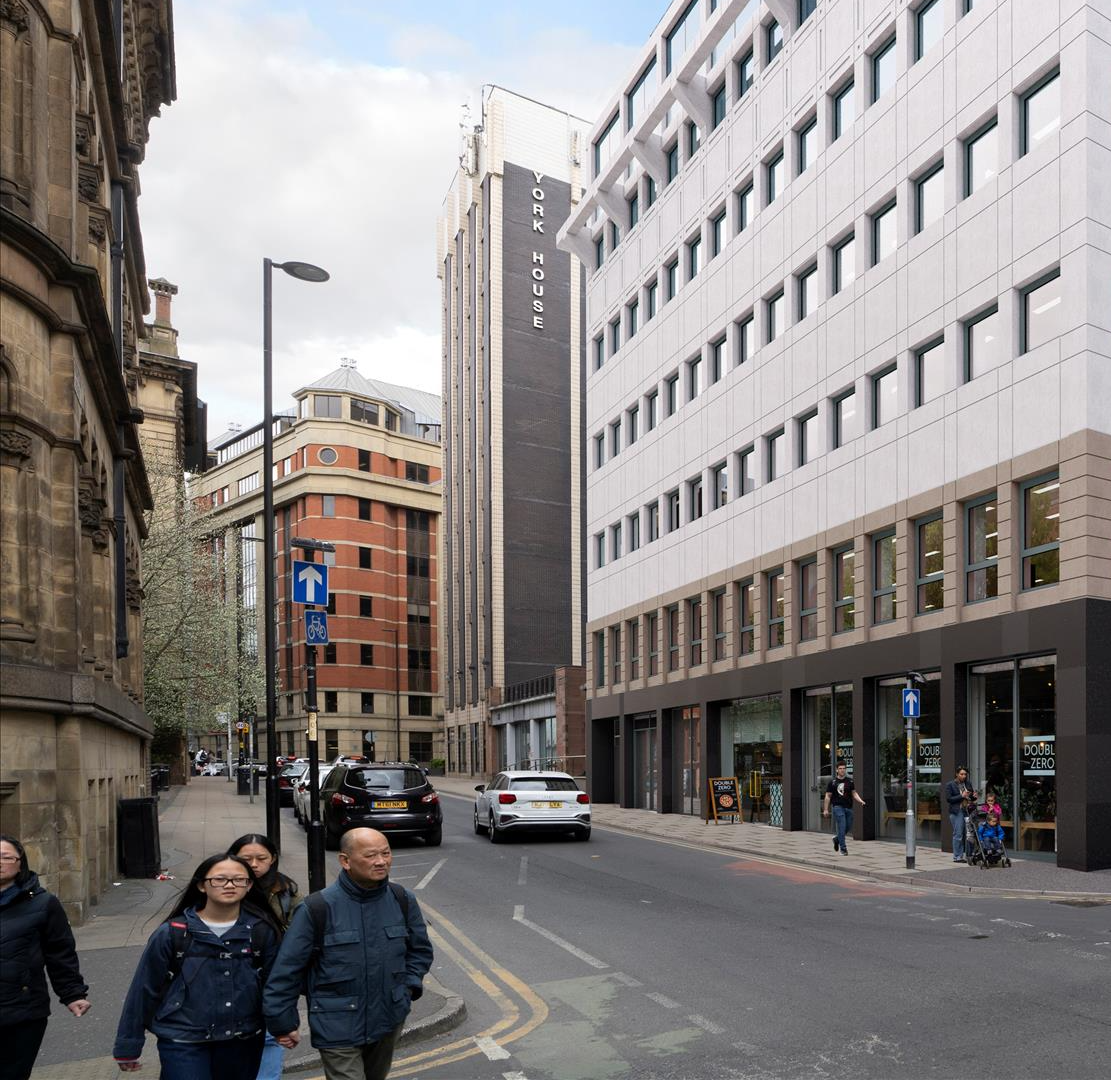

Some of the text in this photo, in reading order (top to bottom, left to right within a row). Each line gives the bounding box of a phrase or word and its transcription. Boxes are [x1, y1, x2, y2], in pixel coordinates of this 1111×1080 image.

[532, 171, 544, 328] YORK HOUSE
[1030, 757, 1055, 769] ZERO
